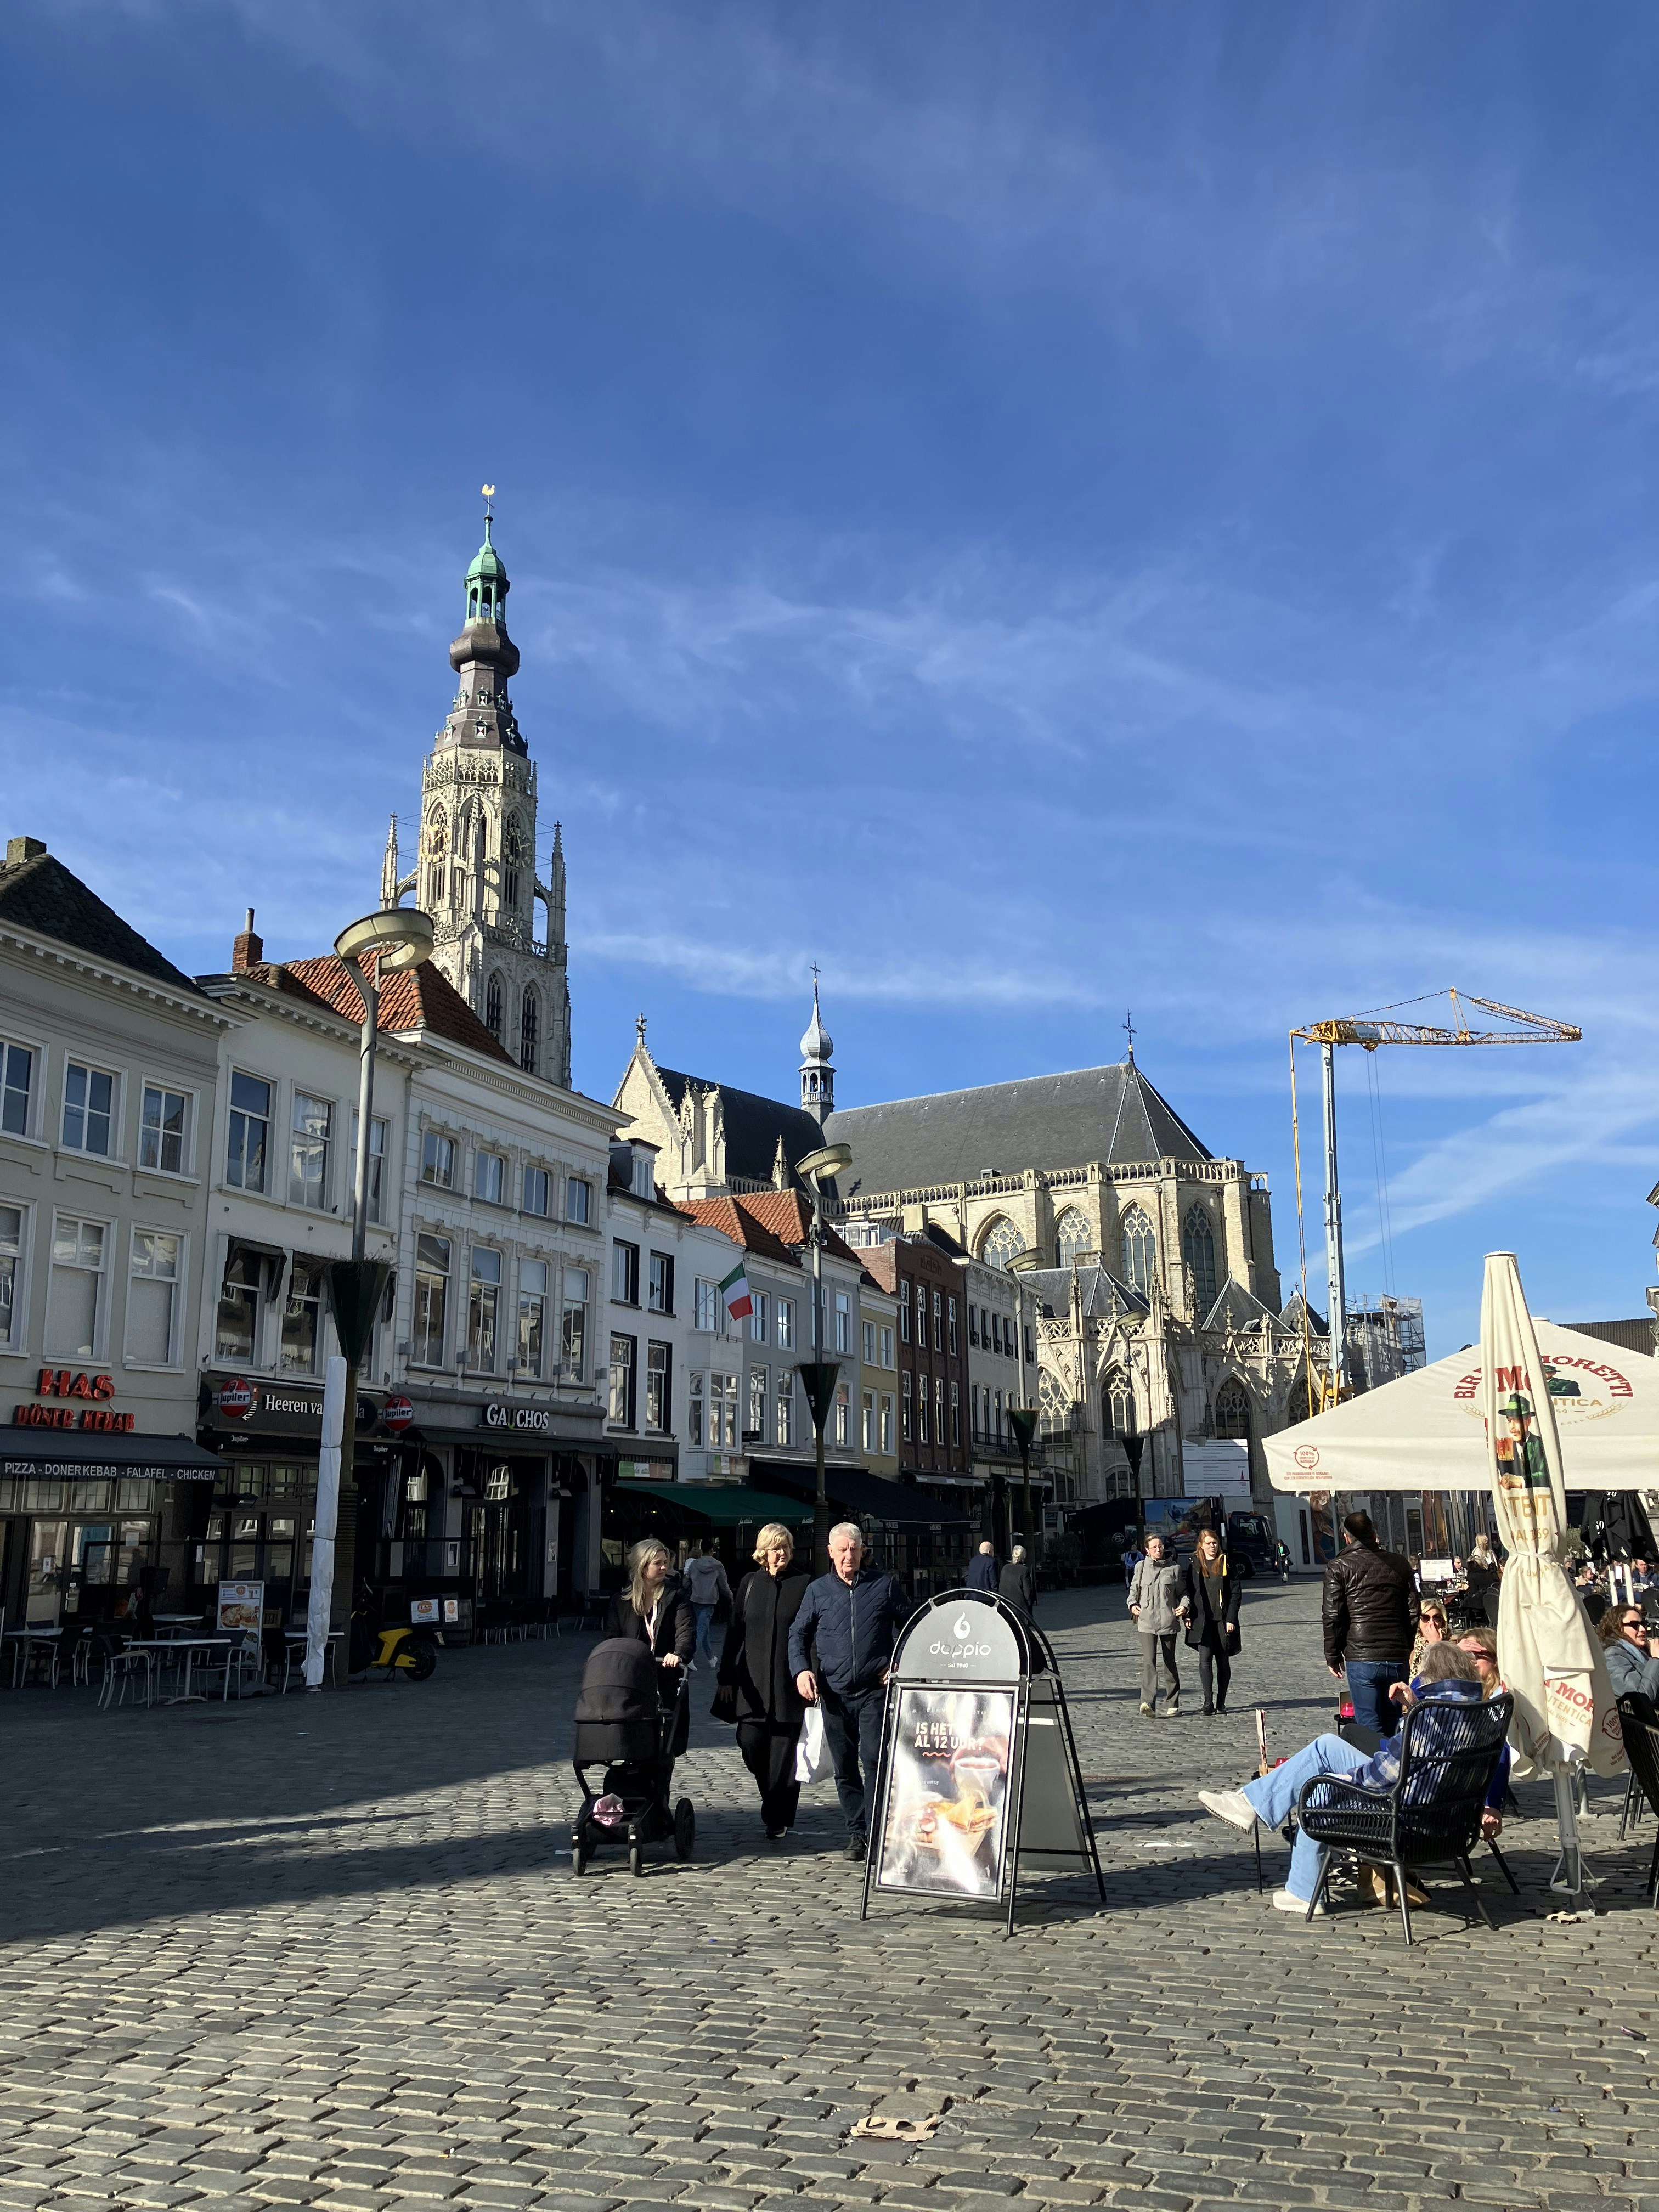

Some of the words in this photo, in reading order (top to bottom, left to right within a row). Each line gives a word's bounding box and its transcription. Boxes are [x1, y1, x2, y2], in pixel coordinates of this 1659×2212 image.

[39, 1369, 115, 1401] HAS
[1454, 1367, 1482, 1398] BIR
[220, 1392, 250, 1403] Jupiler
[266, 1395, 308, 1413] Heeren
[311, 1402, 323, 1414] va
[82, 1409, 135, 1432] KEBAB
[385, 1408, 412, 1419] Jupiler
[5, 1463, 36, 1475] PIZZA
[83, 1465, 117, 1477] KEBAB
[127, 1467, 167, 1479] FALAFEL
[177, 1469, 216, 1480] CHICKEN
[929, 1640, 991, 1658] doppio
[1547, 1694, 1592, 1726] UTENTICA
[916, 1722, 928, 1734] IS
[930, 1722, 954, 1736] HET
[915, 1735, 930, 1748] AL
[934, 1736, 948, 1749] 12
[950, 1737, 986, 1750] UUR?
